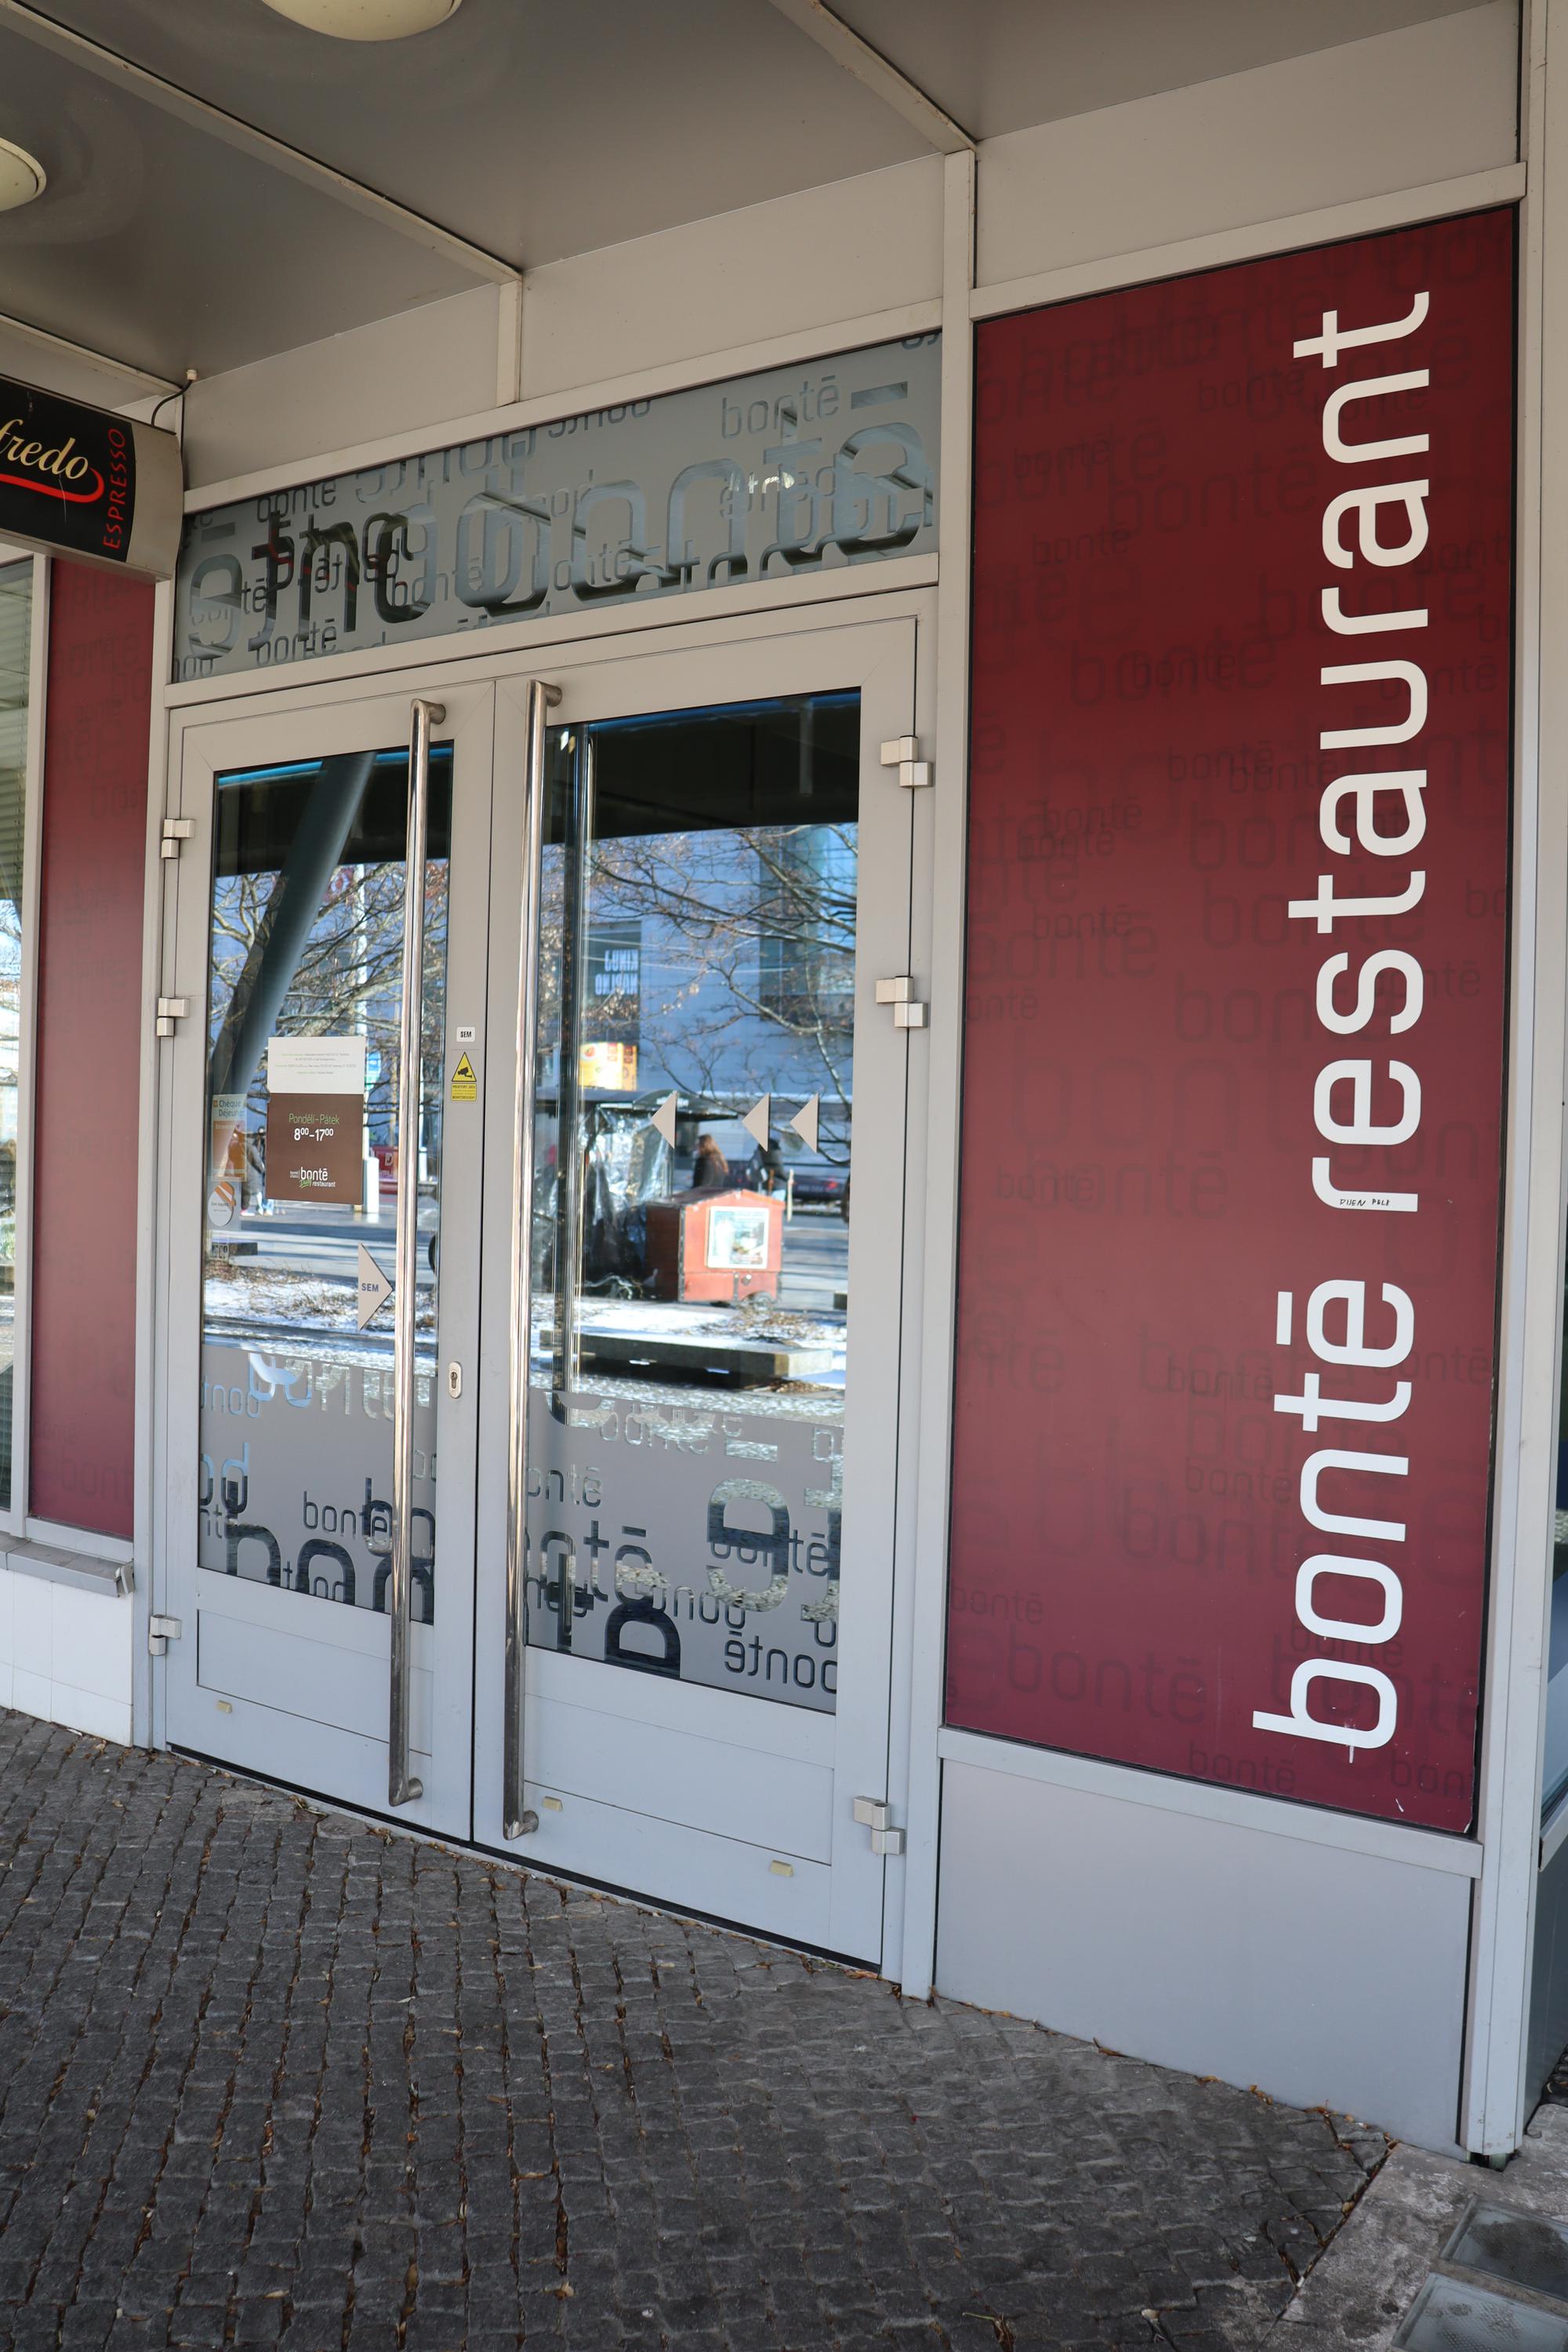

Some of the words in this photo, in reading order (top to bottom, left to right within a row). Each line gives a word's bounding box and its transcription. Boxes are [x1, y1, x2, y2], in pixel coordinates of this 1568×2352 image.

[103, 428, 127, 549] ESPRESSO
[1288, 291, 1430, 1212] restaurant
[361, 1283, 379, 1292] SEM
